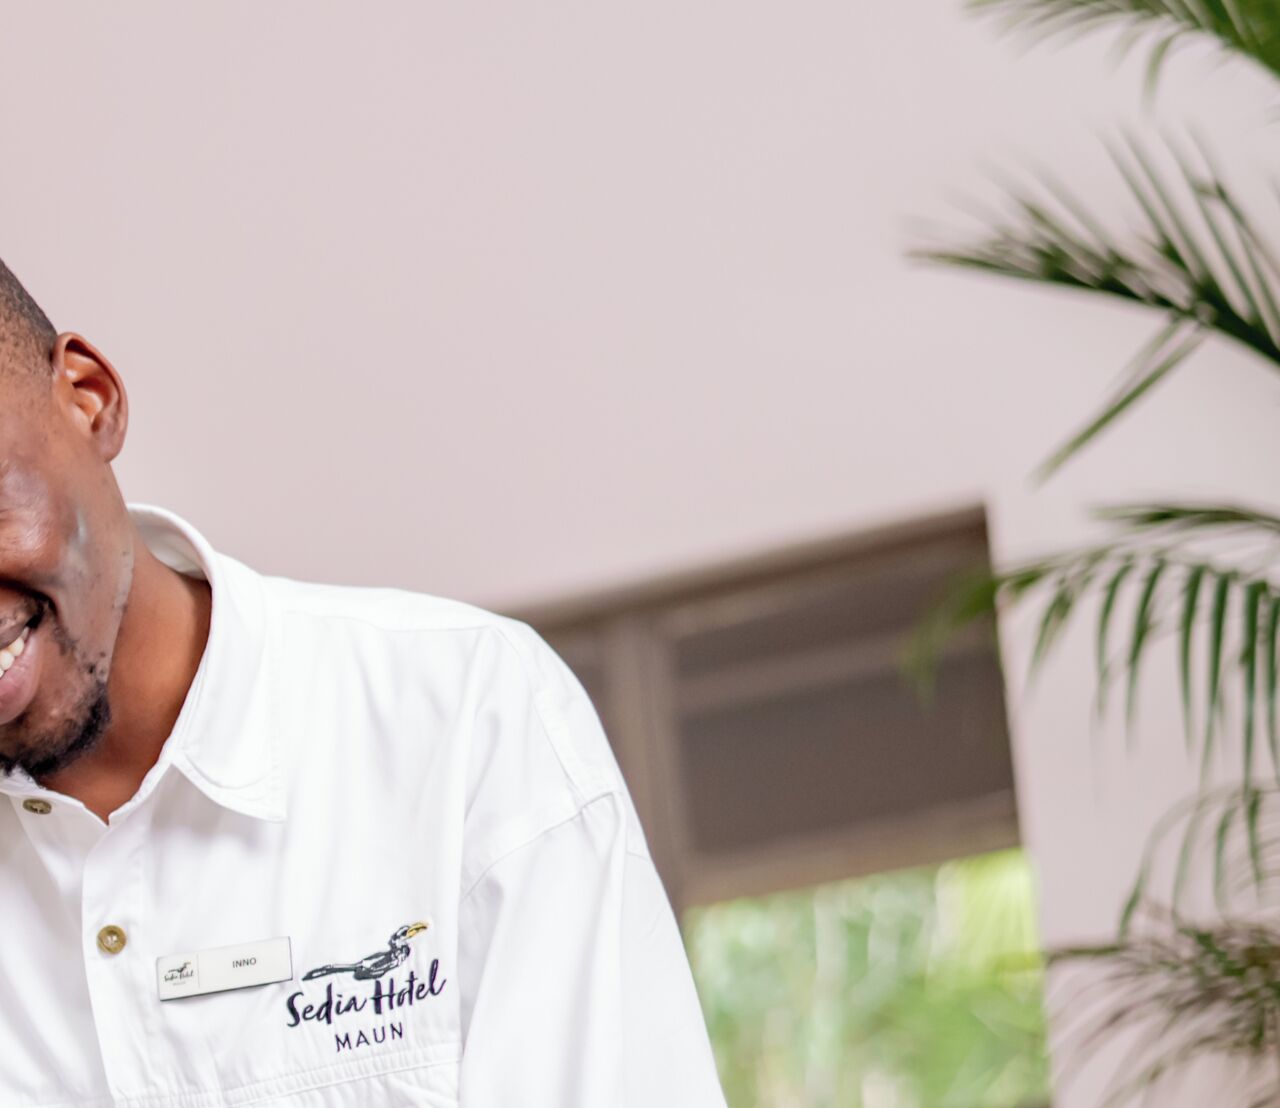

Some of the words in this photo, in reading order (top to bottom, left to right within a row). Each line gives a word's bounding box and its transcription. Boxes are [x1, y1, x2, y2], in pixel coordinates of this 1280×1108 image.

[232, 957, 257, 968] INNO
[286, 982, 368, 1028] Sedia
[365, 958, 447, 1015] Hotel
[334, 1022, 404, 1053] MAUN
